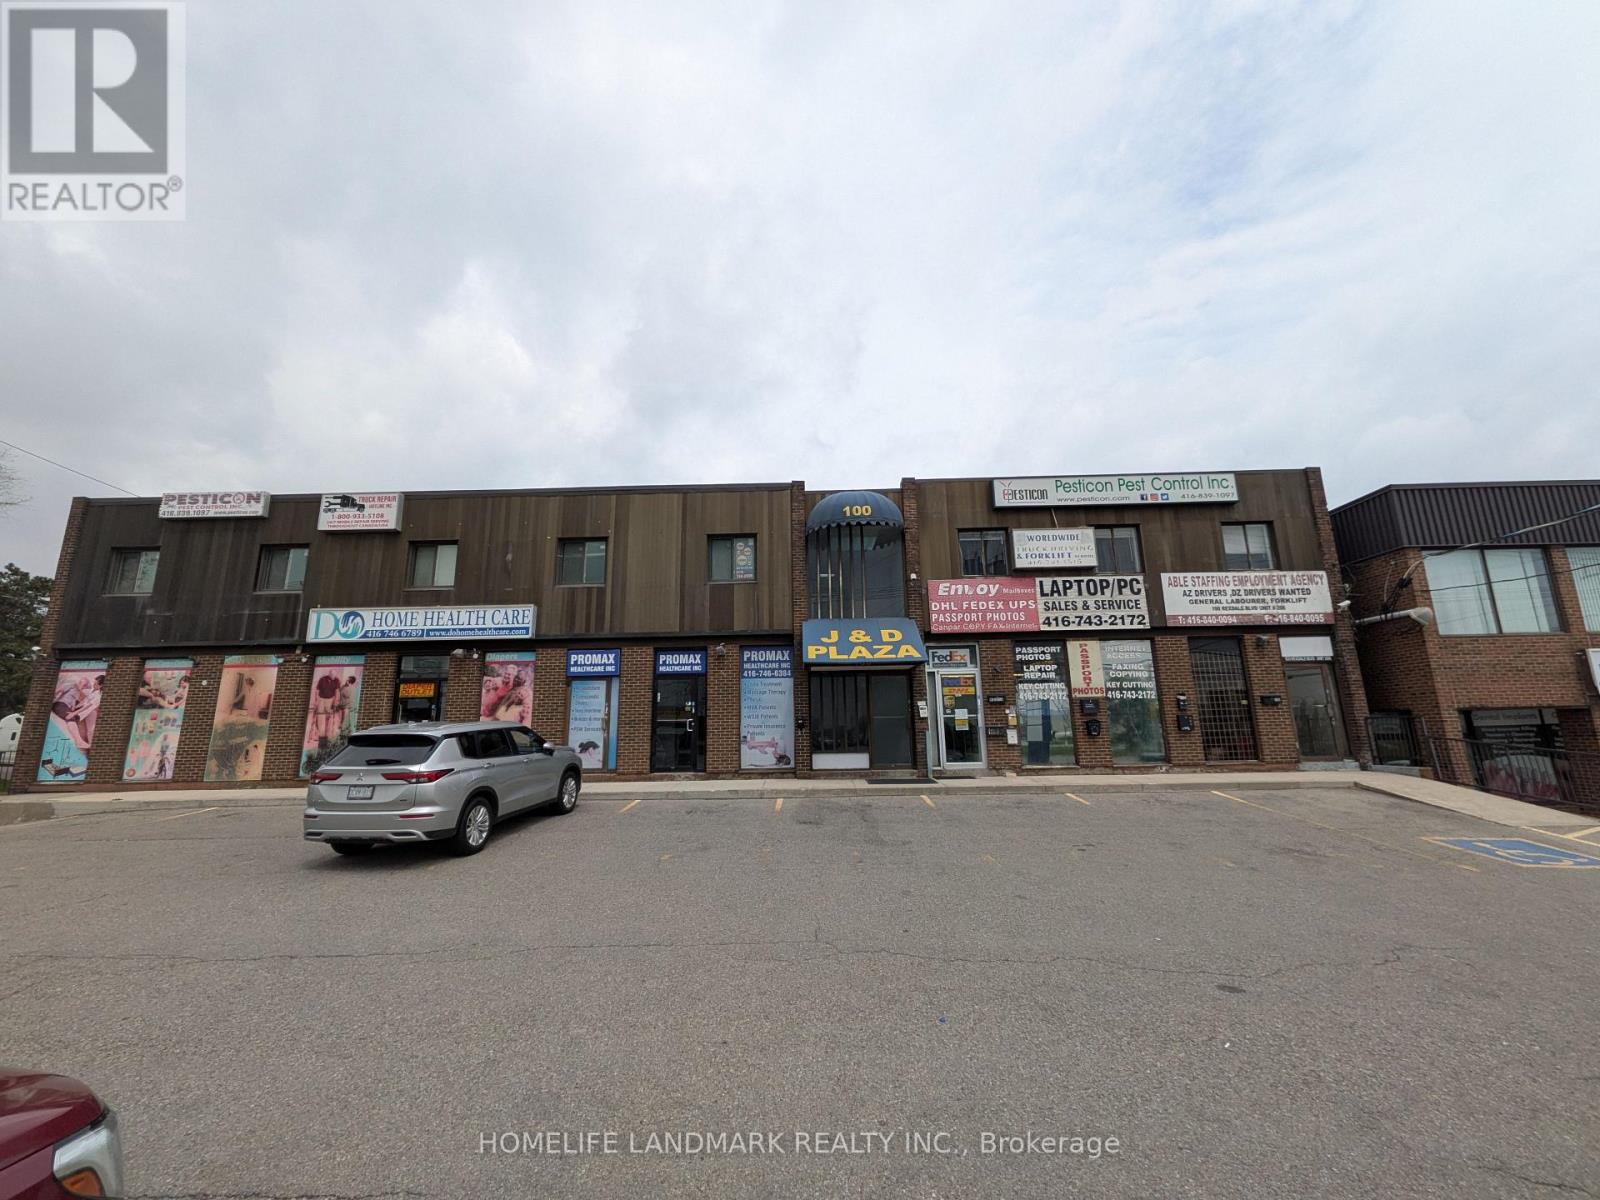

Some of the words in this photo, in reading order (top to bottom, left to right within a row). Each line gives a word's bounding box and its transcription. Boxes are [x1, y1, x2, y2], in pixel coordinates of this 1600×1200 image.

[1055, 479, 1113, 493] Pesticon
[1117, 477, 1145, 492] Pest
[1151, 476, 1203, 491] Control
[1207, 475, 1234, 489] Inc.
[163, 492, 261, 505] PESTICON
[359, 495, 375, 503] TRUCK
[377, 495, 397, 503] REPAIR
[842, 505, 872, 517] 100
[1027, 533, 1080, 542] WORLDWIDE
[1025, 552, 1072, 560] FORKLIFT
[1168, 576, 1189, 588] ABLE
[1191, 575, 1231, 587] STAFFING
[1232, 574, 1287, 587] EMPLOYMENT
[1291, 573, 1325, 586] AGENCY
[1039, 578, 1142, 598] LAPTOP/PC
[1194, 589, 1228, 597] DRIVERS
[1244, 588, 1277, 596] DRIVERS
[1280, 587, 1312, 596] WANTED
[931, 602, 958, 611] DHL
[962, 600, 1004, 610] FEDEX
[1009, 600, 1036, 609] UPS
[1044, 600, 1078, 611] SALES
[1082, 600, 1090, 610] &
[1094, 599, 1141, 610] SERVICE
[372, 610, 420, 627] HOME
[423, 609, 488, 626] HEALTH
[491, 608, 530, 625] CARE
[932, 613, 983, 622] PASSPORT
[987, 612, 1026, 621] PHOTOS
[1042, 614, 1147, 627] 416-743-2172
[1178, 616, 1186, 625] T:
[366, 630, 382, 638] 416
[384, 629, 399, 637] 746
[401, 629, 422, 637] 6789
[429, 628, 526, 636] www.dohomehealthcare.com
[820, 630, 839, 643] J
[848, 629, 872, 643] &
[880, 629, 902, 642] D
[743, 650, 790, 661] PROMAX
[807, 644, 922, 659] PLAZA
[931, 650, 967, 662] FedEx
[1015, 646, 1061, 654] PASSPORT
[570, 653, 615, 665] PROMAX
[659, 653, 701, 665] PROMAX
[1015, 653, 1052, 661] PHOTOS
[1079, 643, 1092, 687] PASSPORT
[1072, 687, 1105, 695] PHOTOS
[1107, 690, 1156, 699] 416-743-2172
